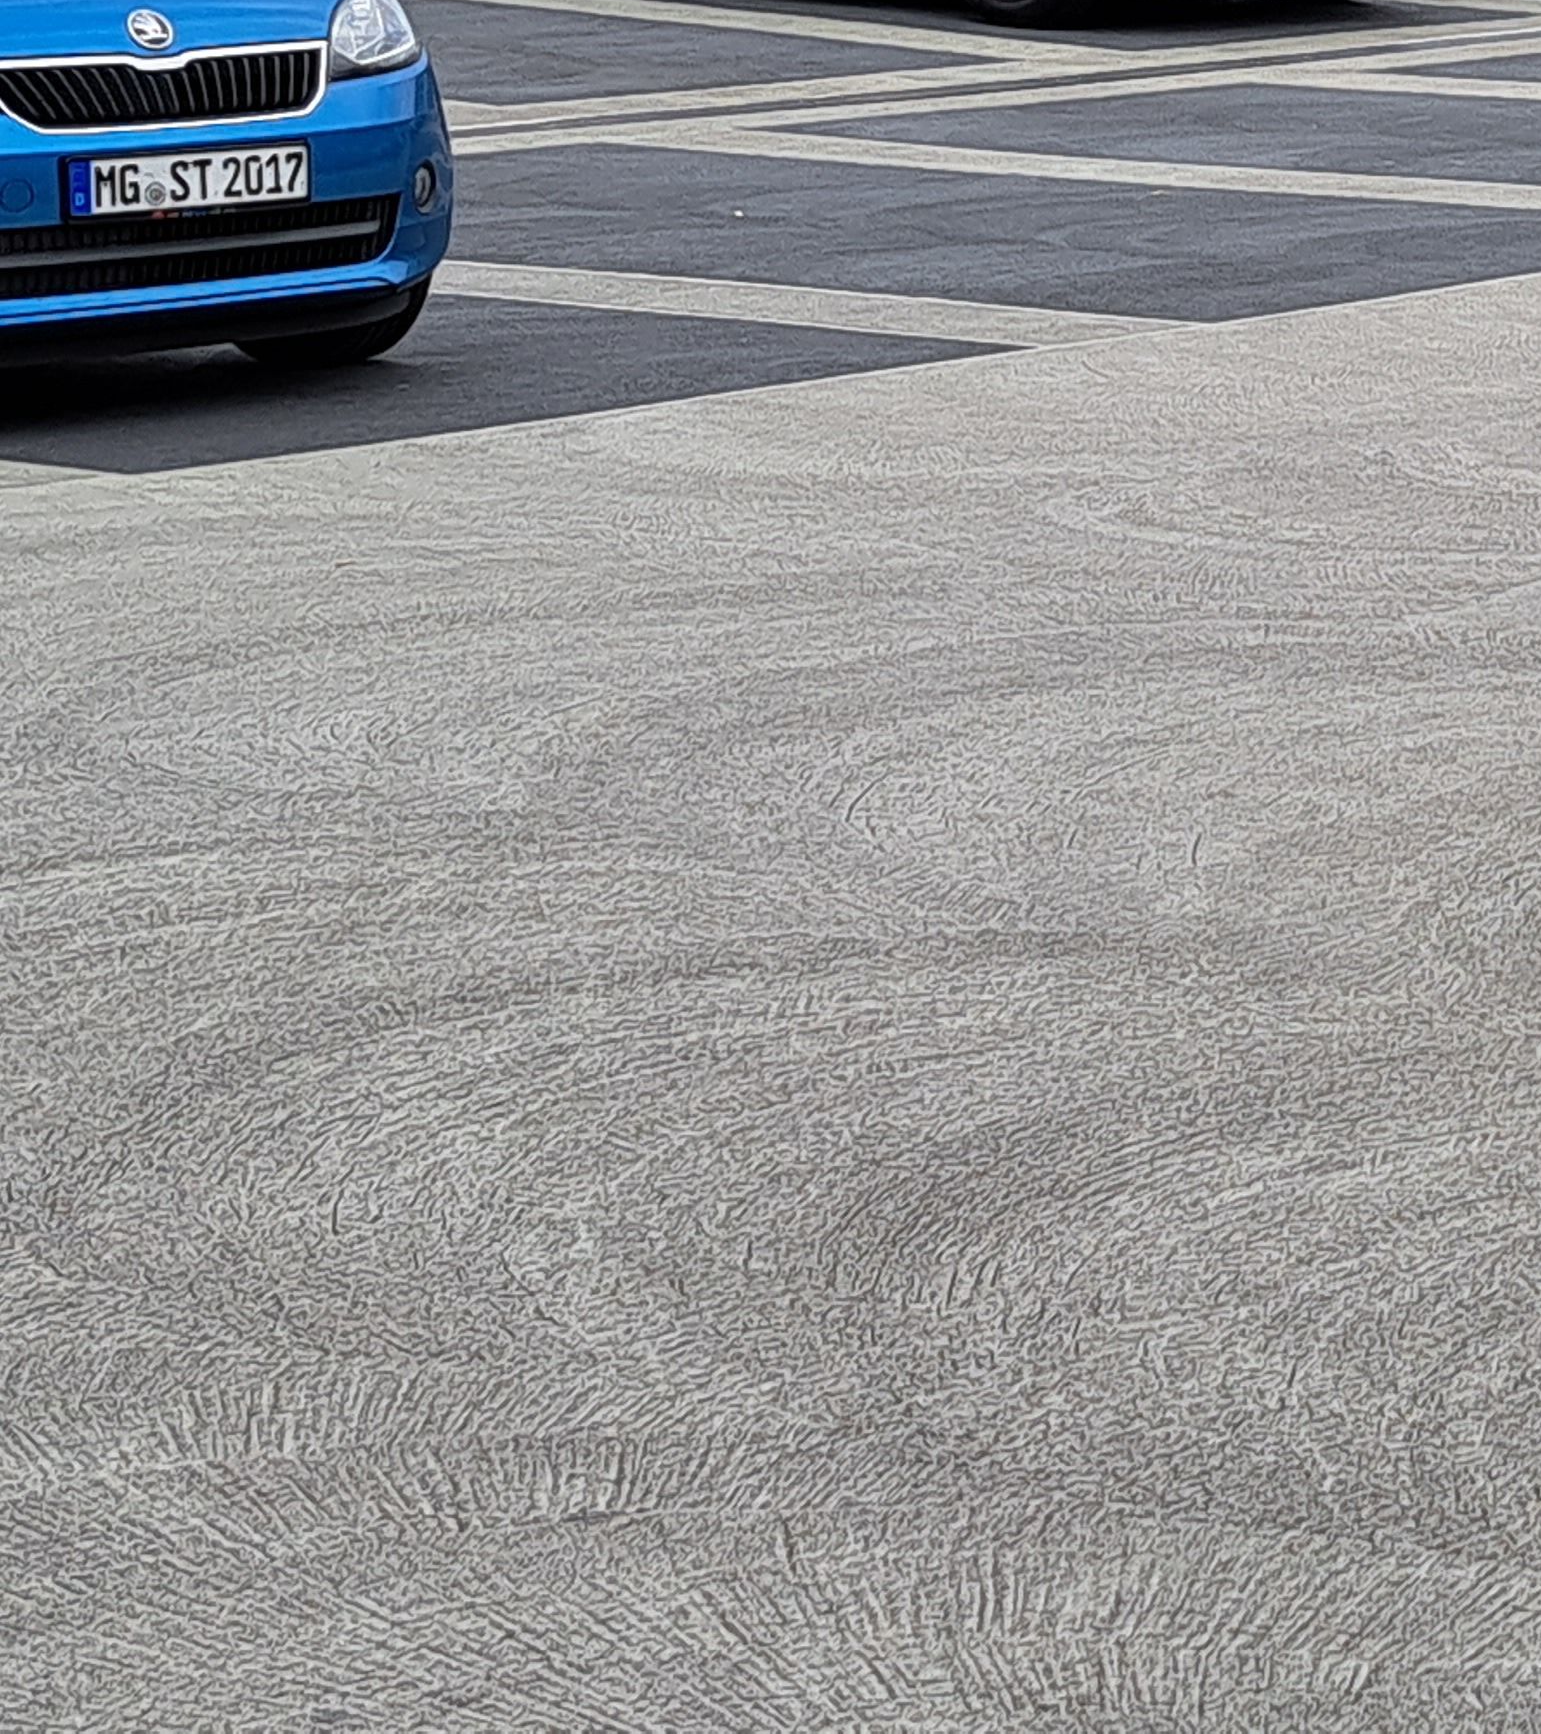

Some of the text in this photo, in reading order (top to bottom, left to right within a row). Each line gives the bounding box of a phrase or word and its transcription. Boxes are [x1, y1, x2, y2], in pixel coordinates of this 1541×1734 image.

[94, 163, 141, 208] MG
[170, 158, 213, 203] ST
[222, 151, 304, 199] 2017
